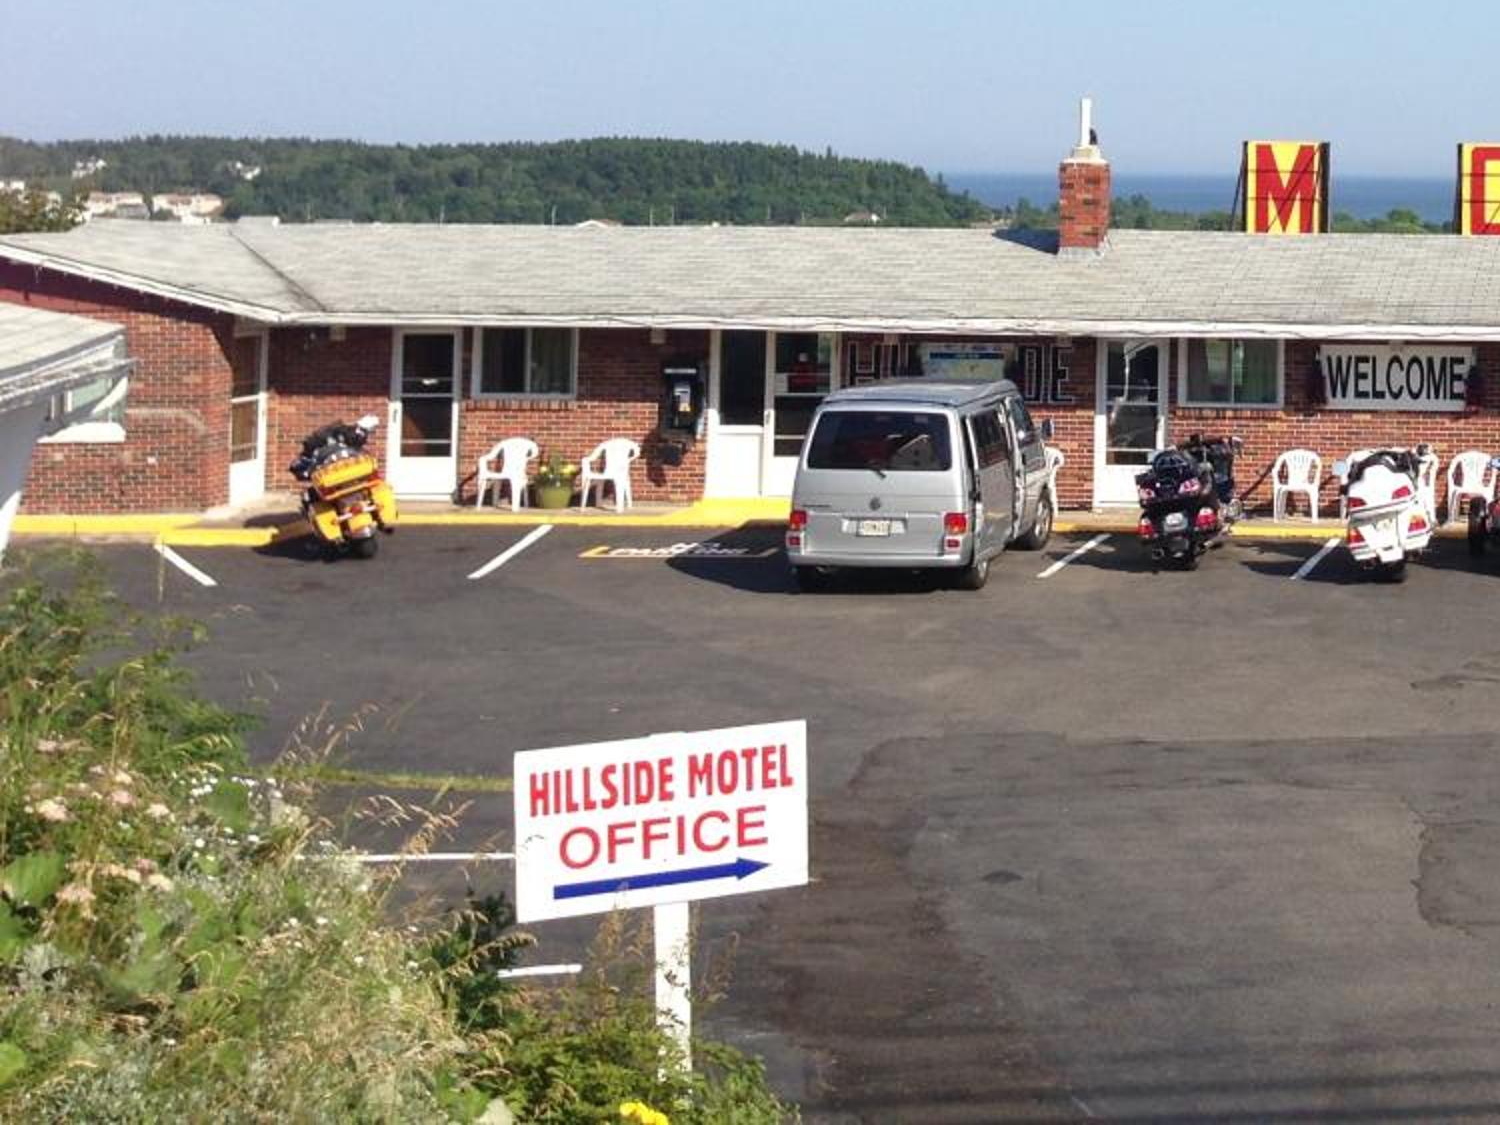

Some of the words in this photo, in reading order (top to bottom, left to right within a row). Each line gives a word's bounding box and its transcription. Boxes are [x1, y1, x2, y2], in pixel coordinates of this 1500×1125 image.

[1327, 355, 1465, 400] WELCOME
[530, 757, 673, 817] HILLSIDE
[688, 744, 793, 799] MOTEL
[559, 805, 769, 869] OFFICE
